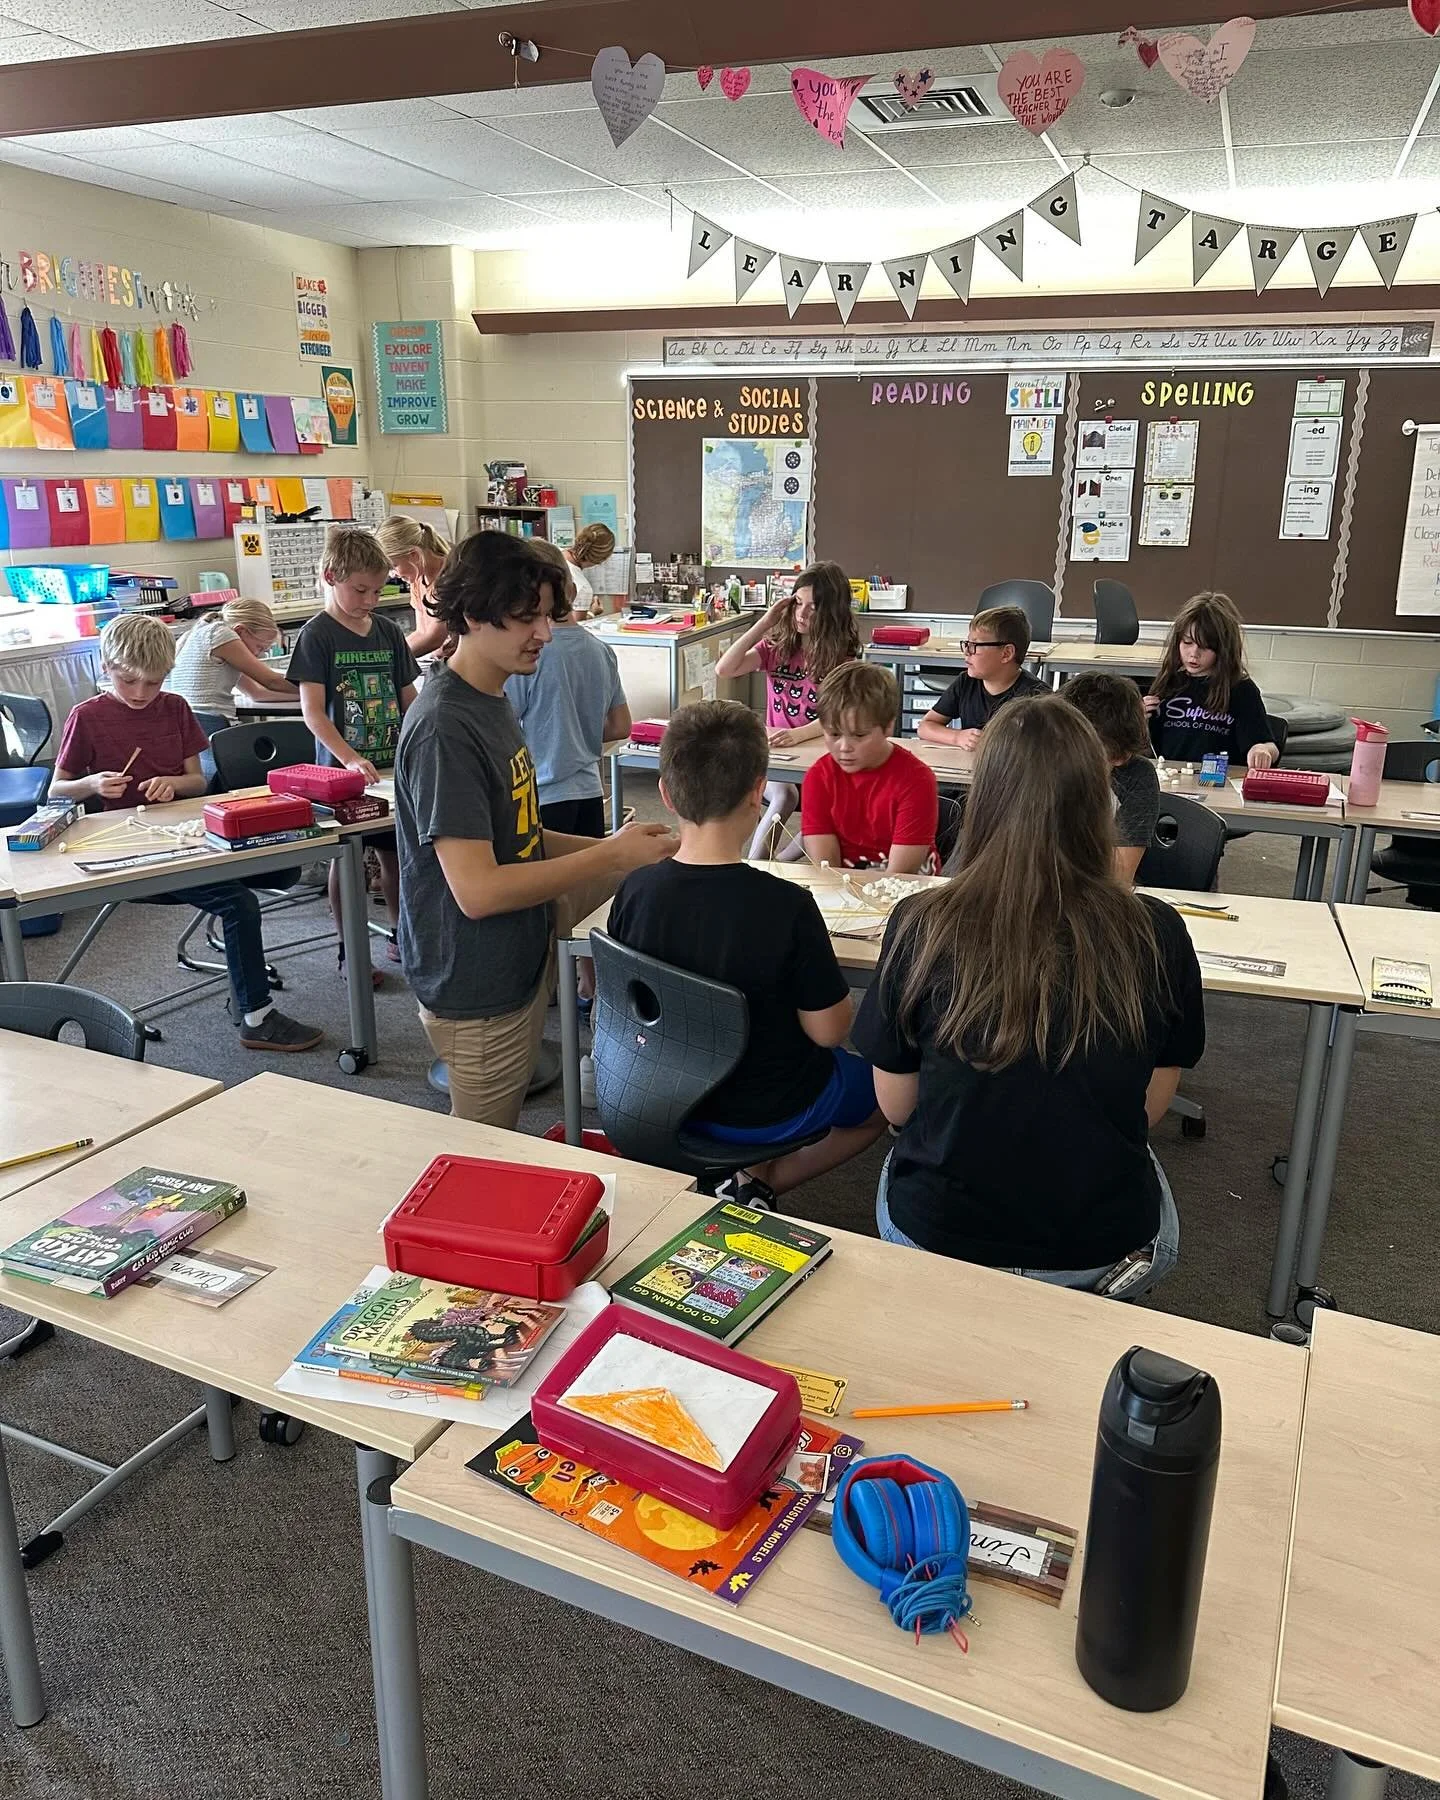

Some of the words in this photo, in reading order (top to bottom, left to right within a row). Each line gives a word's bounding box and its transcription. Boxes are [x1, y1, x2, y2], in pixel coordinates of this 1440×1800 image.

[1016, 74, 1040, 91] YOU
[1044, 69, 1072, 84] ARE
[809, 80, 837, 103] you
[1007, 92, 1028, 105] THE
[1034, 85, 1064, 101] BEST
[816, 101, 834, 121] the
[1012, 102, 1050, 115] TEACHER
[1055, 97, 1069, 110] IN
[1020, 114, 1037, 126] THE
[698, 196, 1068, 291] LEARNING
[297, 300, 328, 318] BIGGER
[385, 344, 432, 355] EXPLORE
[669, 342, 685, 356] Aa
[692, 342, 706, 354] Bb
[714, 342, 728, 356] Cc
[734, 341, 755, 356] Dd
[761, 341, 777, 355] Ee
[784, 340, 800, 360] Ff
[809, 340, 827, 359] Gg
[835, 339, 852, 353] Hh
[860, 339, 879, 354] Ii
[887, 339, 900, 359] Jj
[906, 338, 928, 353] Kk
[936, 337, 956, 352] Ll
[964, 337, 998, 351] Mm
[1006, 336, 1032, 351] Nn
[1042, 336, 1062, 350] Oo
[1073, 335, 1091, 356] Pp
[1099, 334, 1122, 356] Qq
[1130, 334, 1151, 349] Rr
[1160, 334, 1180, 348] Ss
[1188, 333, 1209, 347] Tt
[1214, 333, 1237, 347] Uu
[1243, 332, 1265, 347] Vv
[1272, 332, 1301, 346] Ww
[1310, 330, 1337, 345] Xx
[1345, 330, 1371, 352] Yy
[1378, 329, 1399, 352] Zz
[389, 361, 430, 373] INVENT
[396, 379, 426, 391] MAKE
[386, 396, 437, 408] IMPROVE
[739, 386, 801, 409] SOCIAL
[1010, 388, 1062, 408] SKILL
[713, 399, 724, 418] &
[397, 414, 430, 425] GROW
[1307, 426, 1325, 434] -ed
[1299, 485, 1320, 495] -ing
[1192, 721, 1203, 729] OF
[185, 1182, 216, 1194] DAV
[65, 1248, 119, 1266] CAT
[132, 1256, 145, 1272] CAT
[179, 1225, 195, 1240] CLUB
[169, 1262, 228, 1289] Owen
[629, 1284, 652, 1298] GO!
[653, 1292, 678, 1309] MAN,
[676, 1301, 700, 1317] DOG
[342, 1297, 391, 1341] DRAGON
[356, 1299, 412, 1341] MASTERS
[700, 1314, 720, 1326] GO,
[778, 1492, 815, 1530] XCLUSIVE
[750, 1530, 781, 1564] MODELS
